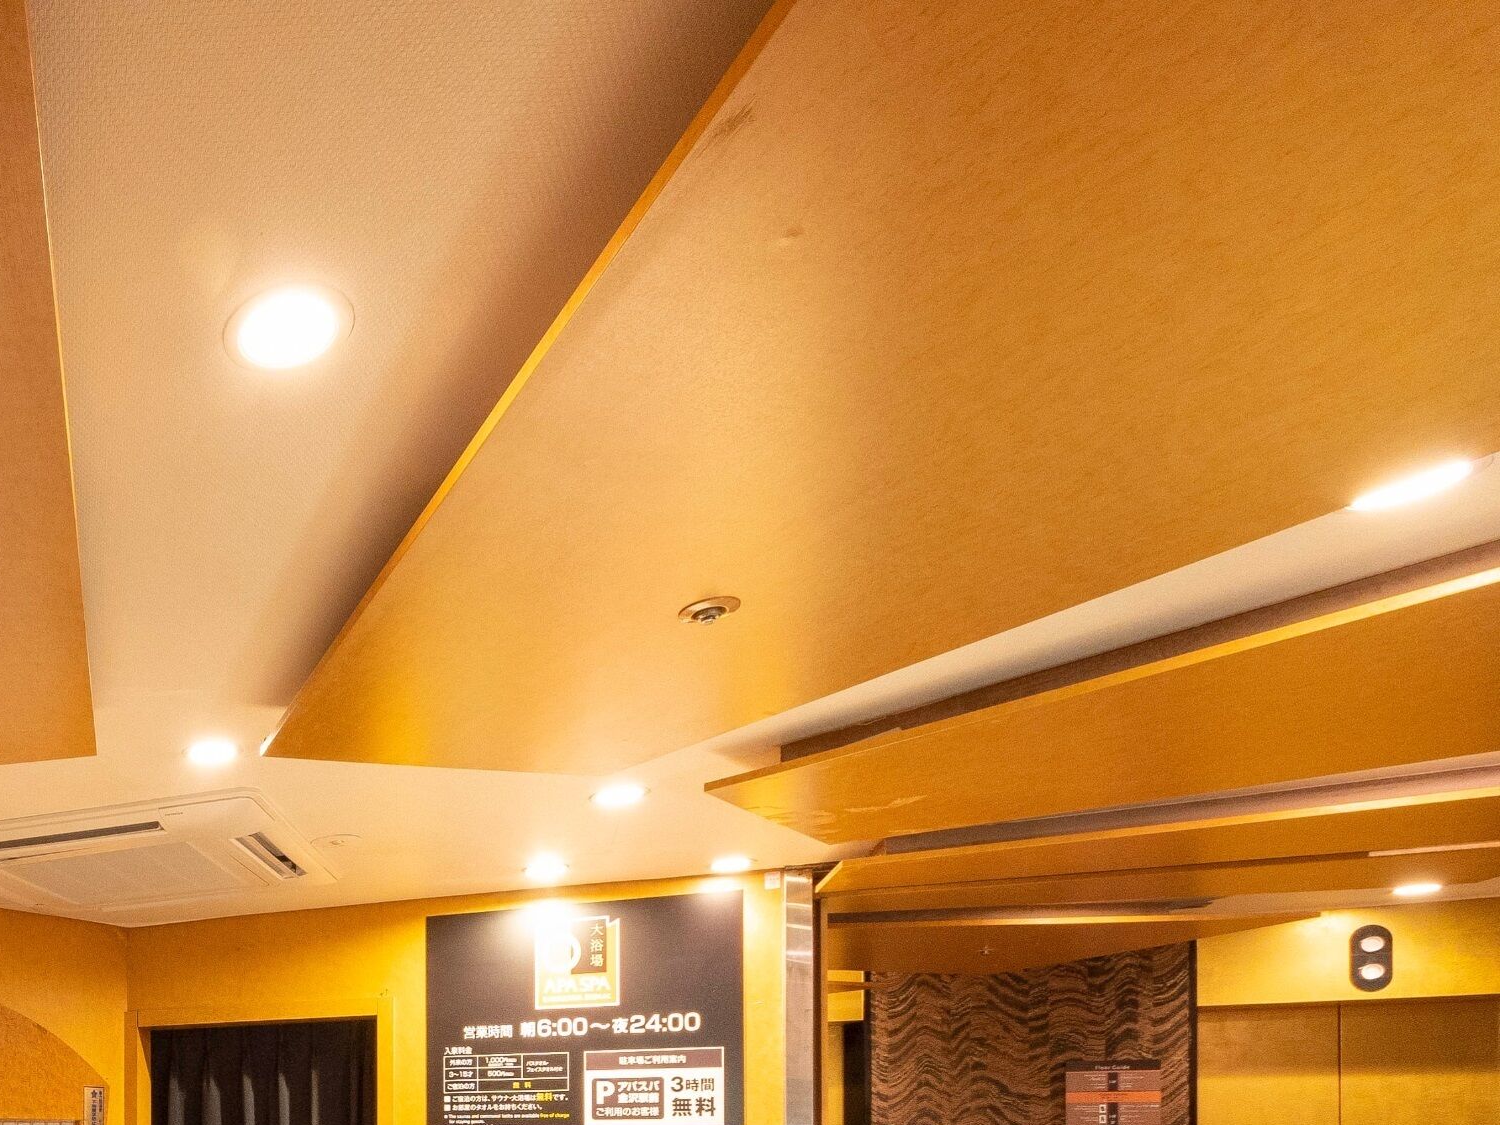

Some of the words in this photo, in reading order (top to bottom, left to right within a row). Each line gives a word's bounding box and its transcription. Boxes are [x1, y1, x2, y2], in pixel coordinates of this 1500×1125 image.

[590, 923, 604, 967] 大浴場
[579, 976, 611, 990] SPA
[463, 1025, 513, 1039] 営業時間
[671, 1077, 715, 1092] 3時間
[596, 1081, 615, 1104] P
[618, 1081, 660, 1091] アパスパ
[596, 1107, 659, 1116] ご利用のお客様
[672, 1097, 716, 1116] 無料
